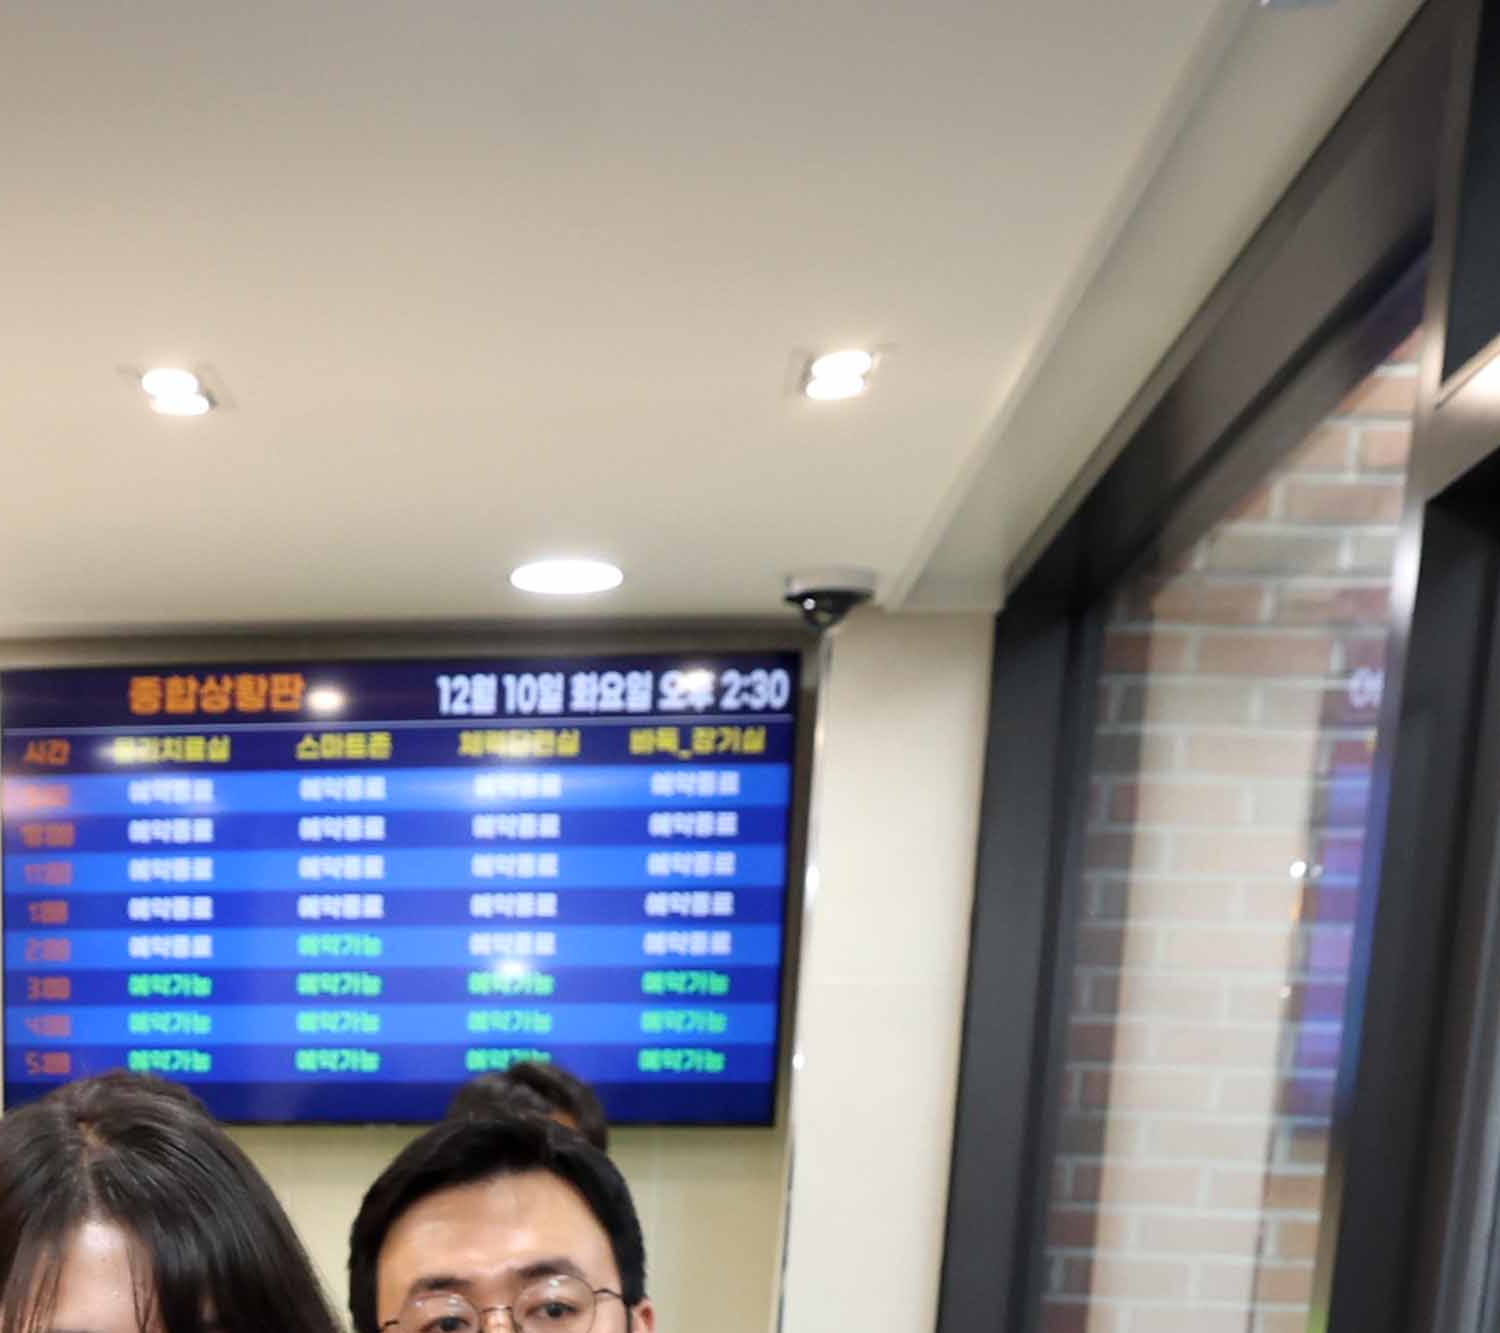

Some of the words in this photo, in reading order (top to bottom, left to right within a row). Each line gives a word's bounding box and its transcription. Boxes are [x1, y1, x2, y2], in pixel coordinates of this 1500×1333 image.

[129, 673, 305, 715] 종합상황판
[436, 673, 498, 715] 12월
[502, 672, 565, 714] 10일
[570, 671, 653, 713] 화요일
[719, 669, 790, 711] 2:30
[295, 731, 393, 760] 스마트존
